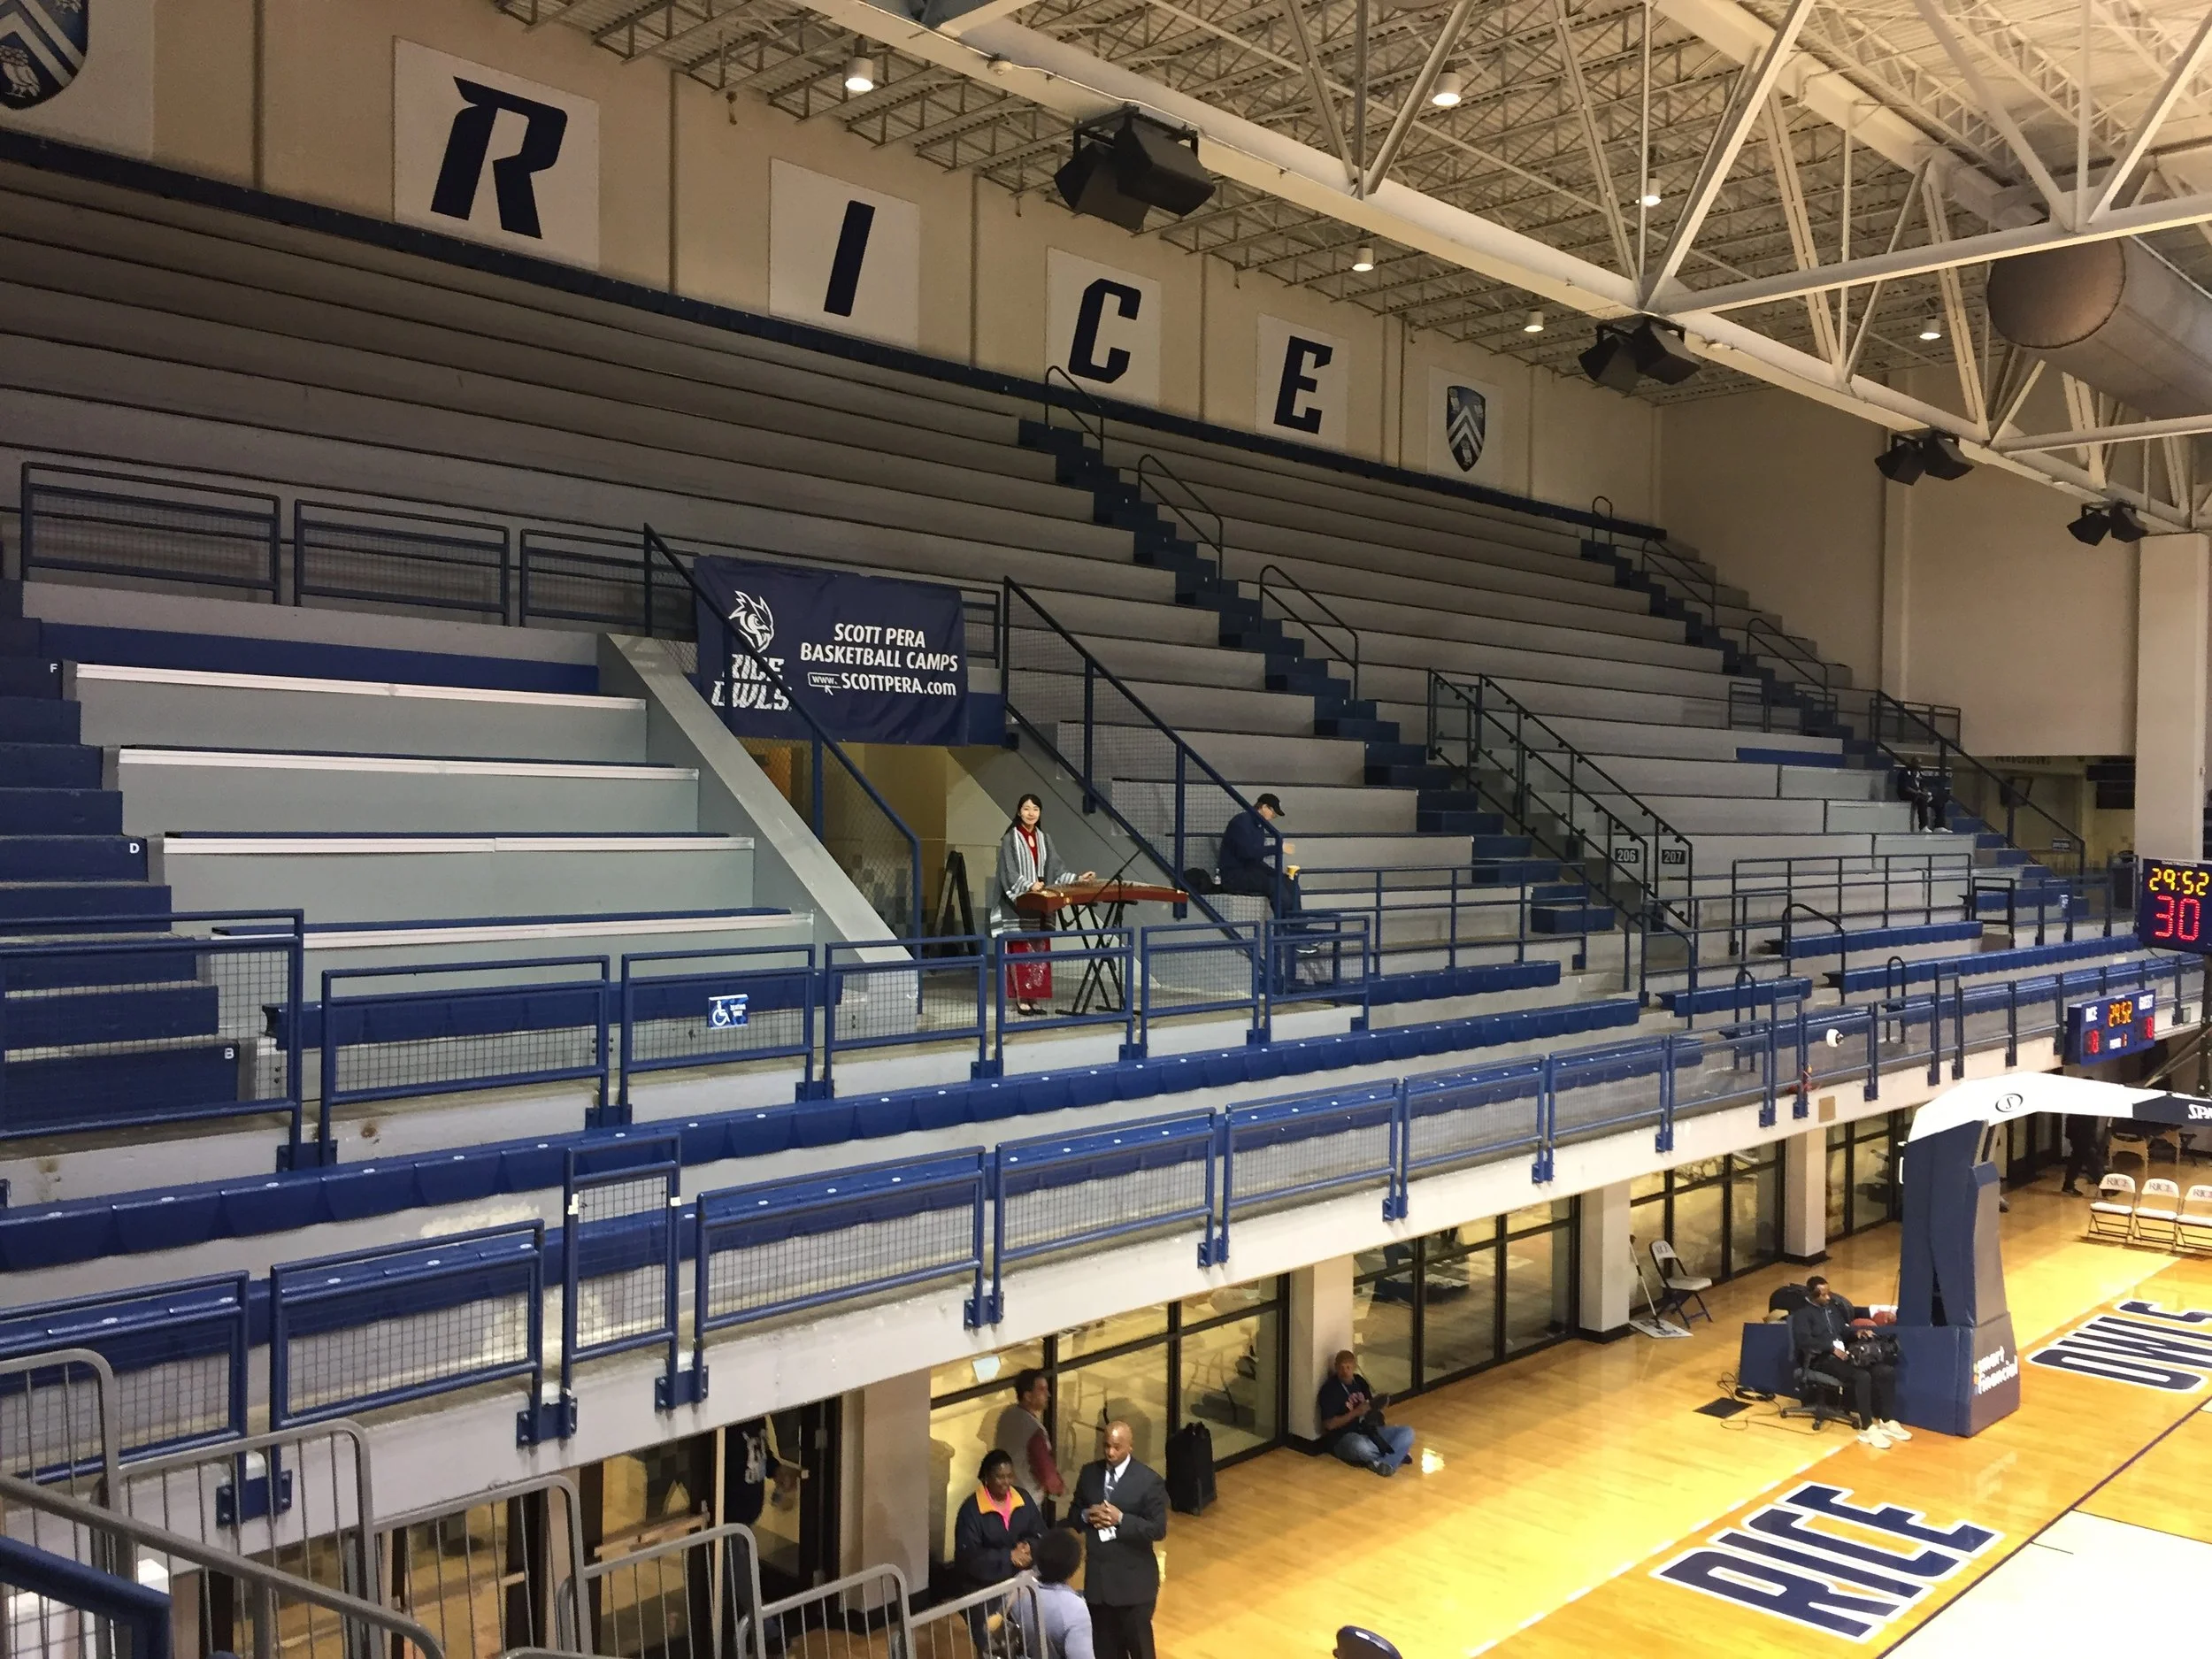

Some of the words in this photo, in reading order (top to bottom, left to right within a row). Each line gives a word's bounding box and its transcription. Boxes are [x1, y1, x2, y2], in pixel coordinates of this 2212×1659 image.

[834, 622, 881, 645] SCOTT
[886, 627, 926, 649] PERA
[800, 642, 901, 668] BASKETBALL
[906, 651, 958, 672] CAMPS
[50, 663, 58, 673] F
[129, 842, 140, 854] D
[1617, 849, 1636, 862] 206
[1663, 850, 1682, 863] 207
[2148, 867, 2210, 896] 29:52
[2154, 895, 2200, 941] 30
[224, 1048, 234, 1060] B
[1649, 1480, 2005, 1643] RICE
